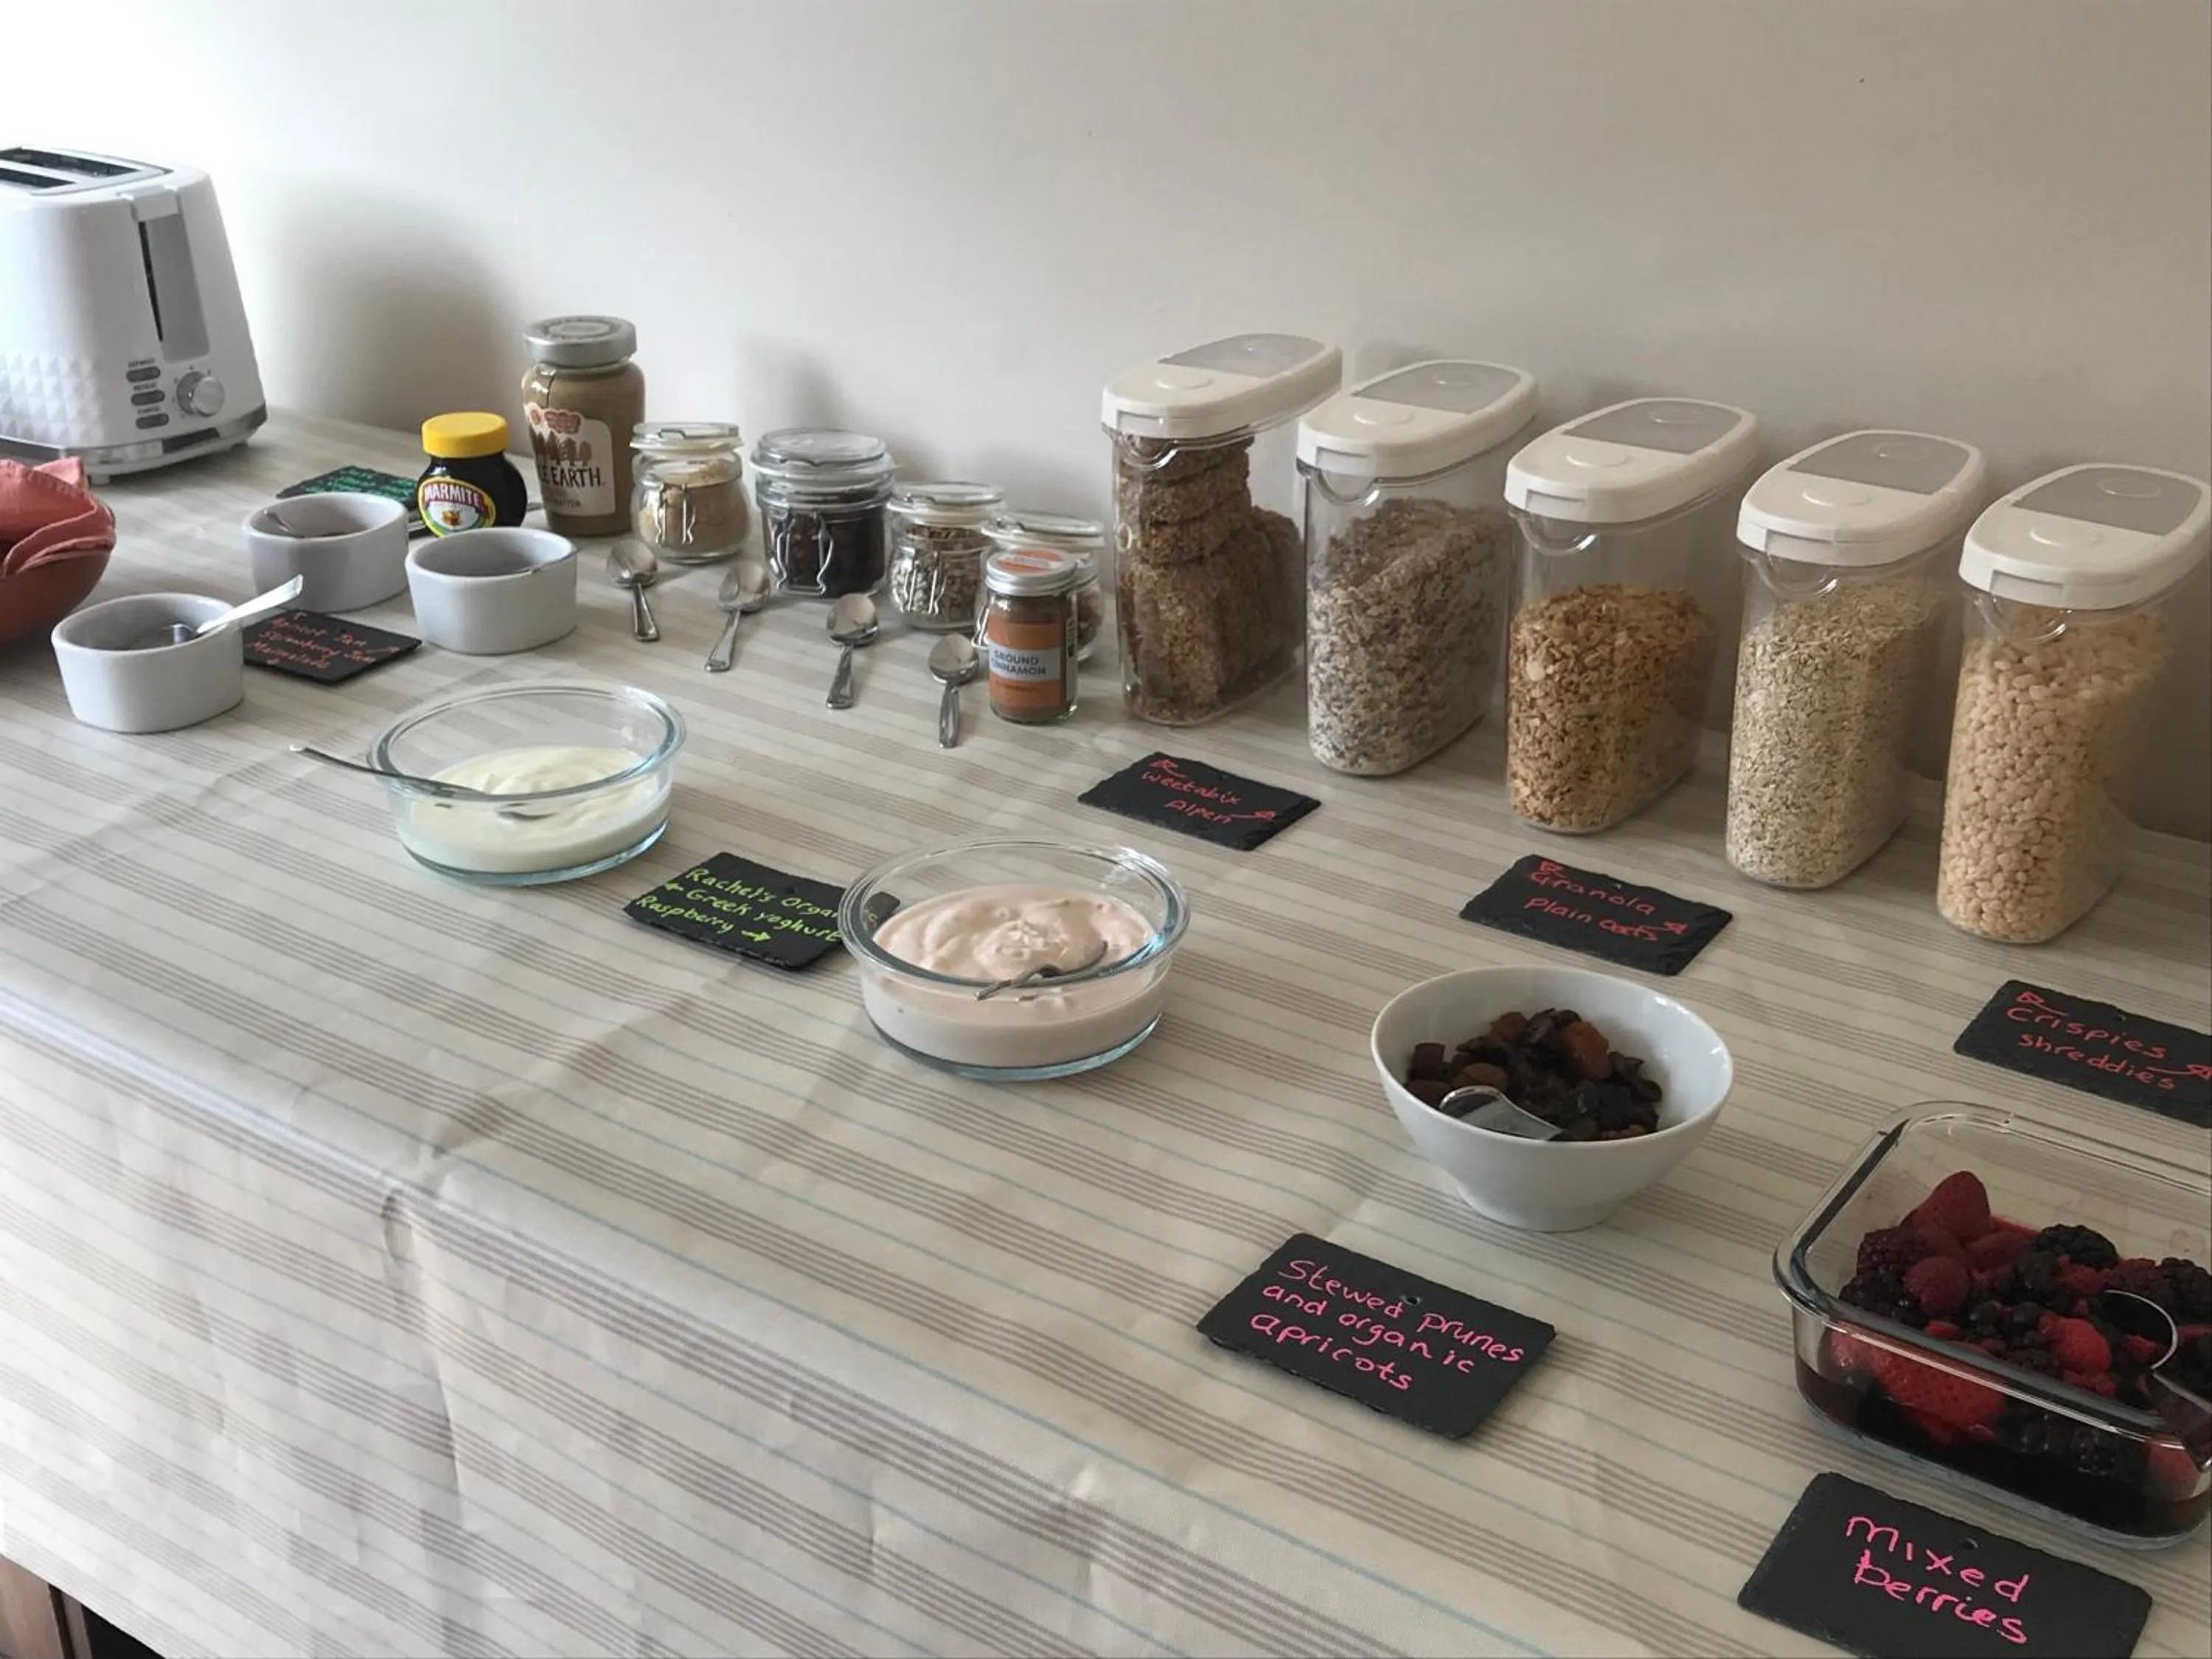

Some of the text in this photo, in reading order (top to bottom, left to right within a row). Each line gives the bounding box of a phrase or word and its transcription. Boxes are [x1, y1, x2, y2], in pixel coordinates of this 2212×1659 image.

[425, 483, 481, 508] MARMITE
[551, 467, 601, 488] EARTH
[685, 868, 775, 902] Rachel's
[686, 889, 752, 916] Greek
[1531, 870, 1656, 915] Granola
[636, 895, 734, 933] Raspberry
[2006, 1006, 2166, 1060] Crispies
[1279, 1259, 1405, 1318] Stewed
[1262, 1284, 1475, 1374] and organic
